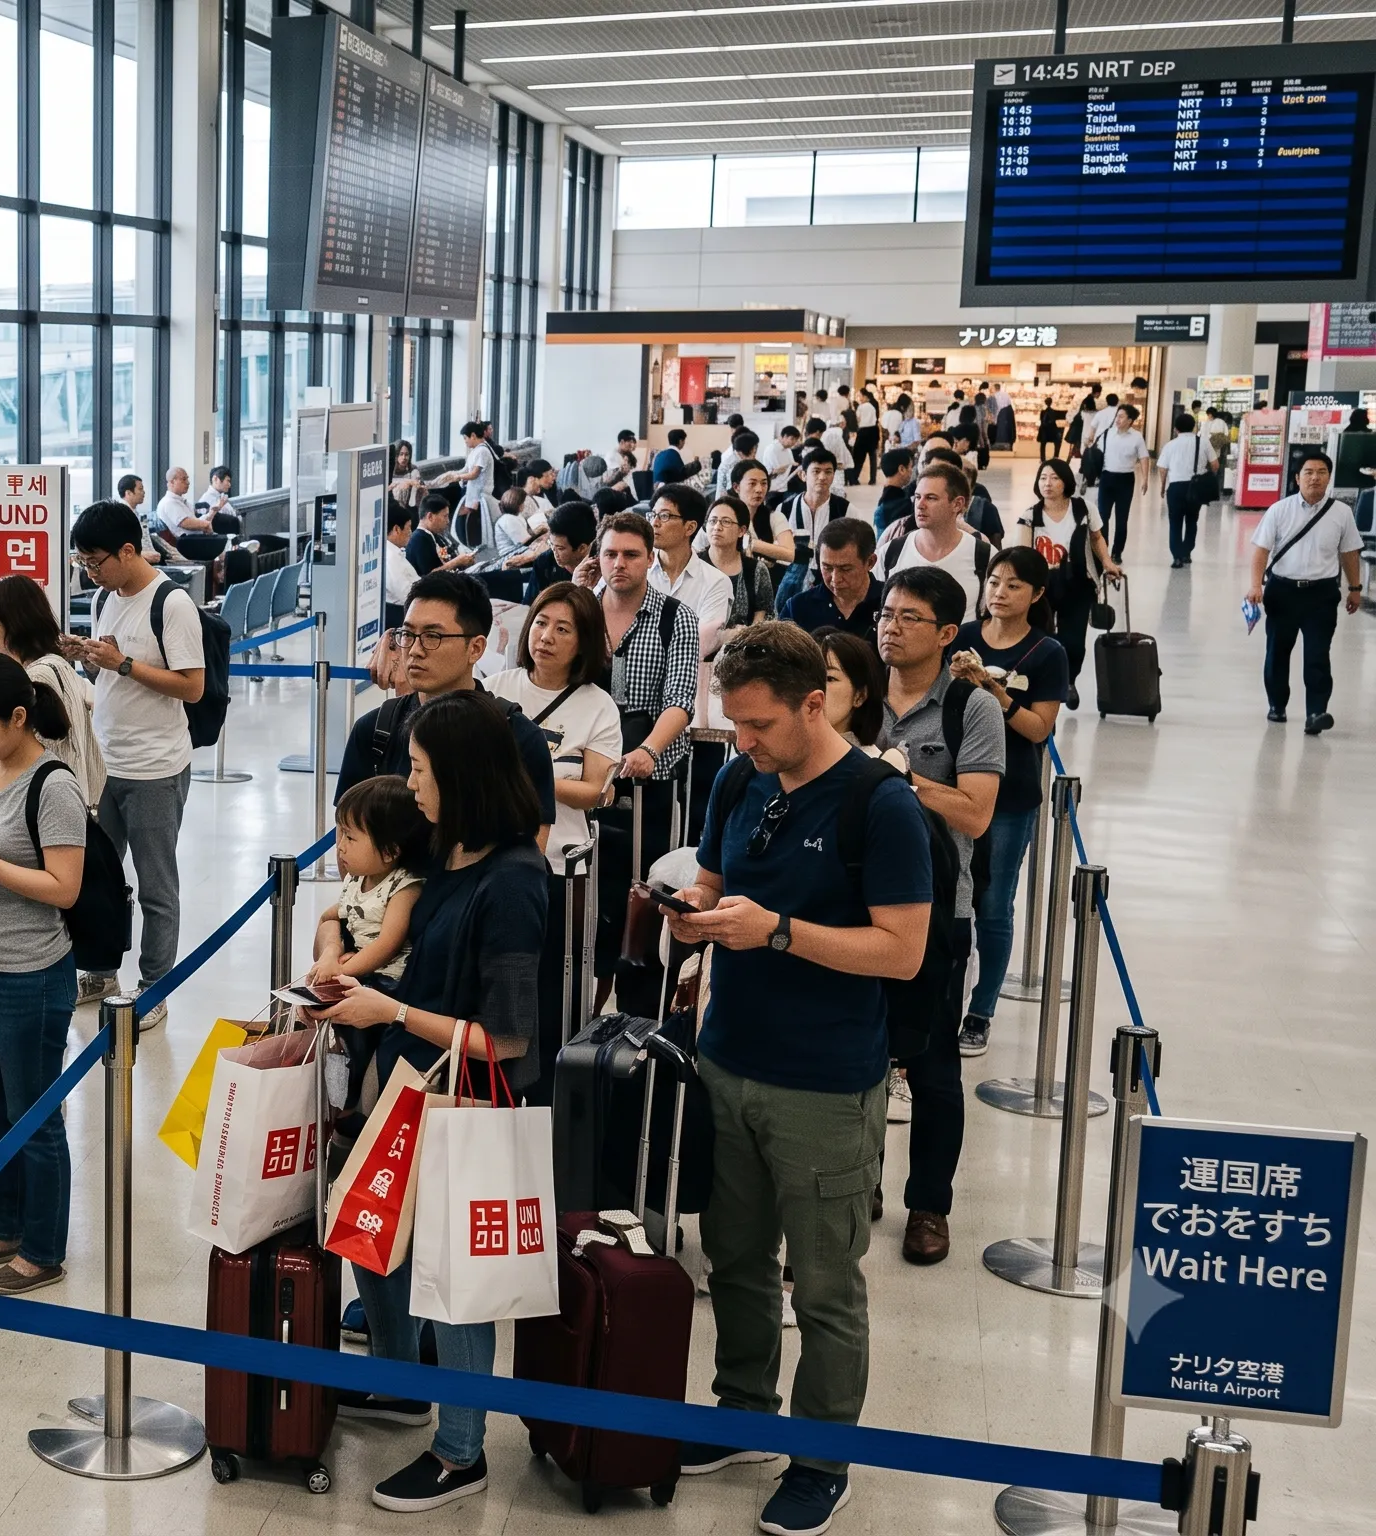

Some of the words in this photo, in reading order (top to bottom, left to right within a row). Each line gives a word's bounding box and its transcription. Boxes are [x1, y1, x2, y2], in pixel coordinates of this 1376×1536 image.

[1022, 62, 1079, 82] 14:45
[1088, 60, 1133, 80] NRT
[1141, 61, 1175, 77] DEP
[1178, 98, 1202, 108] NRT
[1177, 109, 1201, 119] NRT
[1176, 120, 1200, 131] NRT
[1175, 139, 1198, 149] NRT
[1174, 150, 1198, 160] NRT
[1173, 161, 1197, 171] NRT
[959, 326, 1058, 347] ナリタ空港
[1179, 1156, 1302, 1198] 運国席
[519, 1205, 538, 1224] UNI
[1143, 1202, 1332, 1247] でおをすち
[521, 1227, 541, 1250] QLO
[1142, 1245, 1227, 1284] Wait
[1238, 1254, 1327, 1292] Here
[1169, 1353, 1284, 1382] ナリタ空港
[1171, 1376, 1219, 1394] Narita
[1223, 1381, 1281, 1400] Airport
